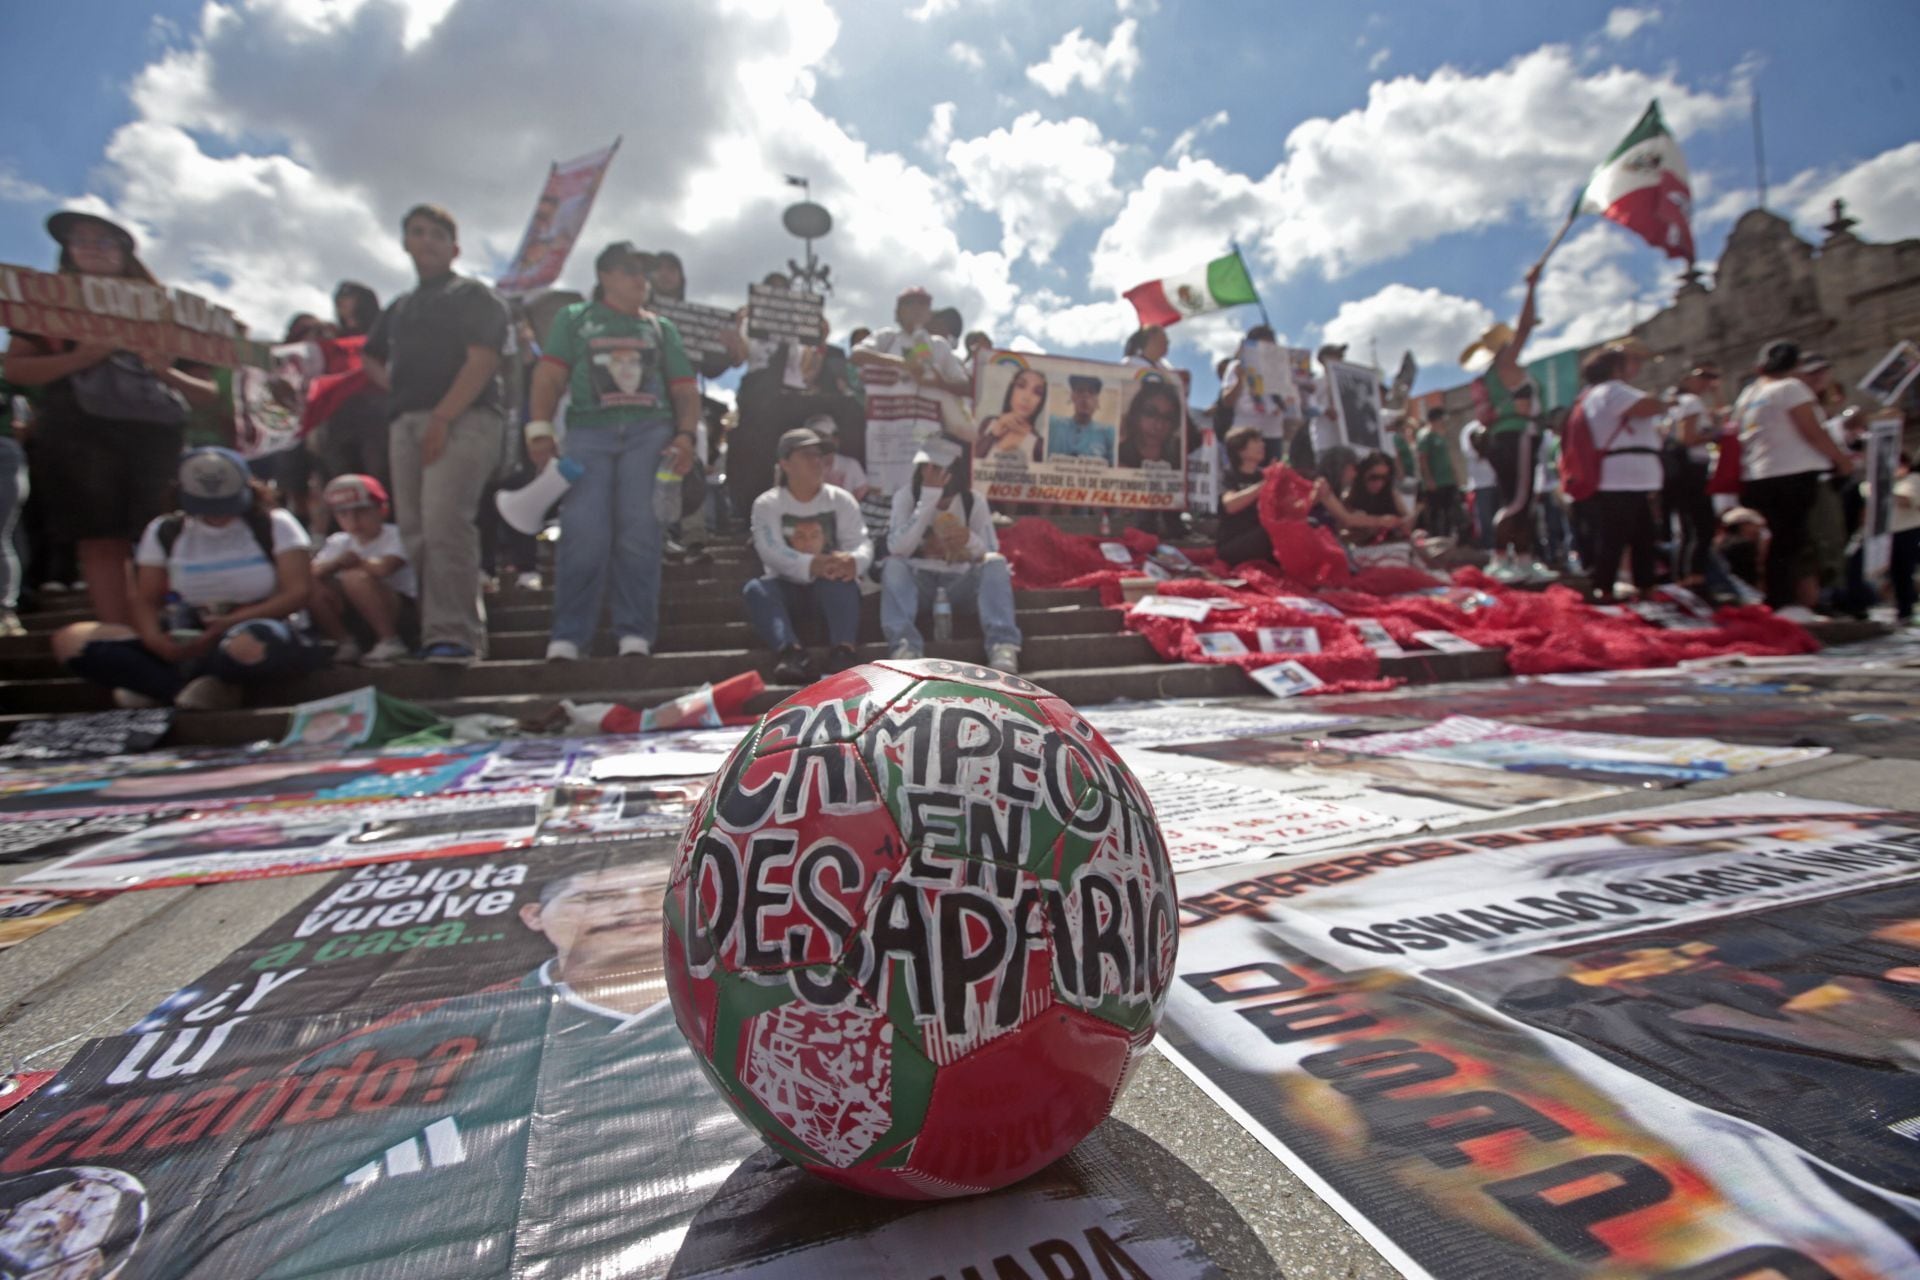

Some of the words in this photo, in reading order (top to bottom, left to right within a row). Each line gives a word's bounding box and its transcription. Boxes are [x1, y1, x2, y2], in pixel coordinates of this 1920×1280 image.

[987, 484, 1023, 497] NOS
[1026, 486, 1088, 501] SIGUEN
[1091, 489, 1174, 505] FALTANDO
[352, 860, 412, 879] La
[907, 793, 1031, 899] EN
[313, 863, 528, 912] pelota
[1179, 841, 1473, 928] UERREROS
[294, 890, 515, 938] vuelve
[1328, 890, 1640, 954] OSWALDO
[250, 941, 306, 970] a
[183, 967, 308, 1022] ¿Y
[2, 1037, 477, 1173] cuándo?
